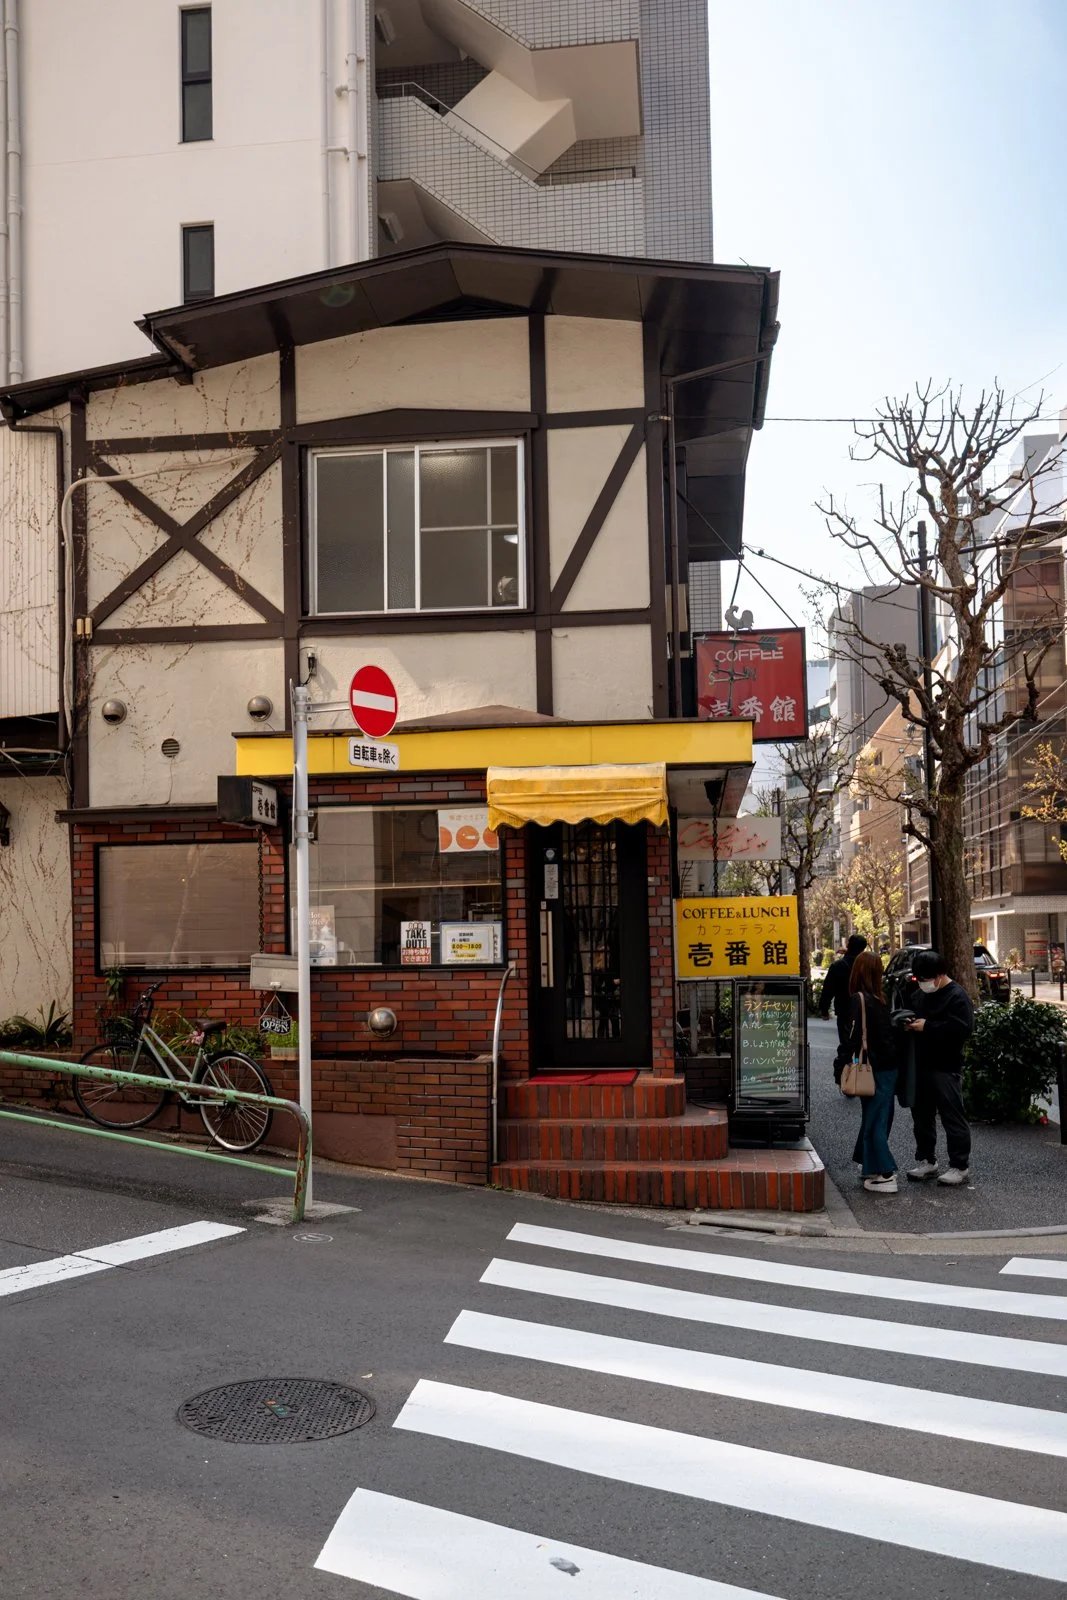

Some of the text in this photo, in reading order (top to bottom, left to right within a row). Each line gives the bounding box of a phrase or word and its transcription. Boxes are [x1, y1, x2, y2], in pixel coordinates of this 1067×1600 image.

[715, 647, 784, 662] COFFEE
[353, 744, 396, 765] 自転車を除く
[682, 906, 790, 919] COFFEE&LUNCH
[405, 930, 427, 939] TAKE
[697, 923, 778, 936] カフェテラス
[688, 940, 788, 967] 壱番館
[743, 1000, 796, 1012] ランチセット
[261, 1019, 288, 1033] OPEN
